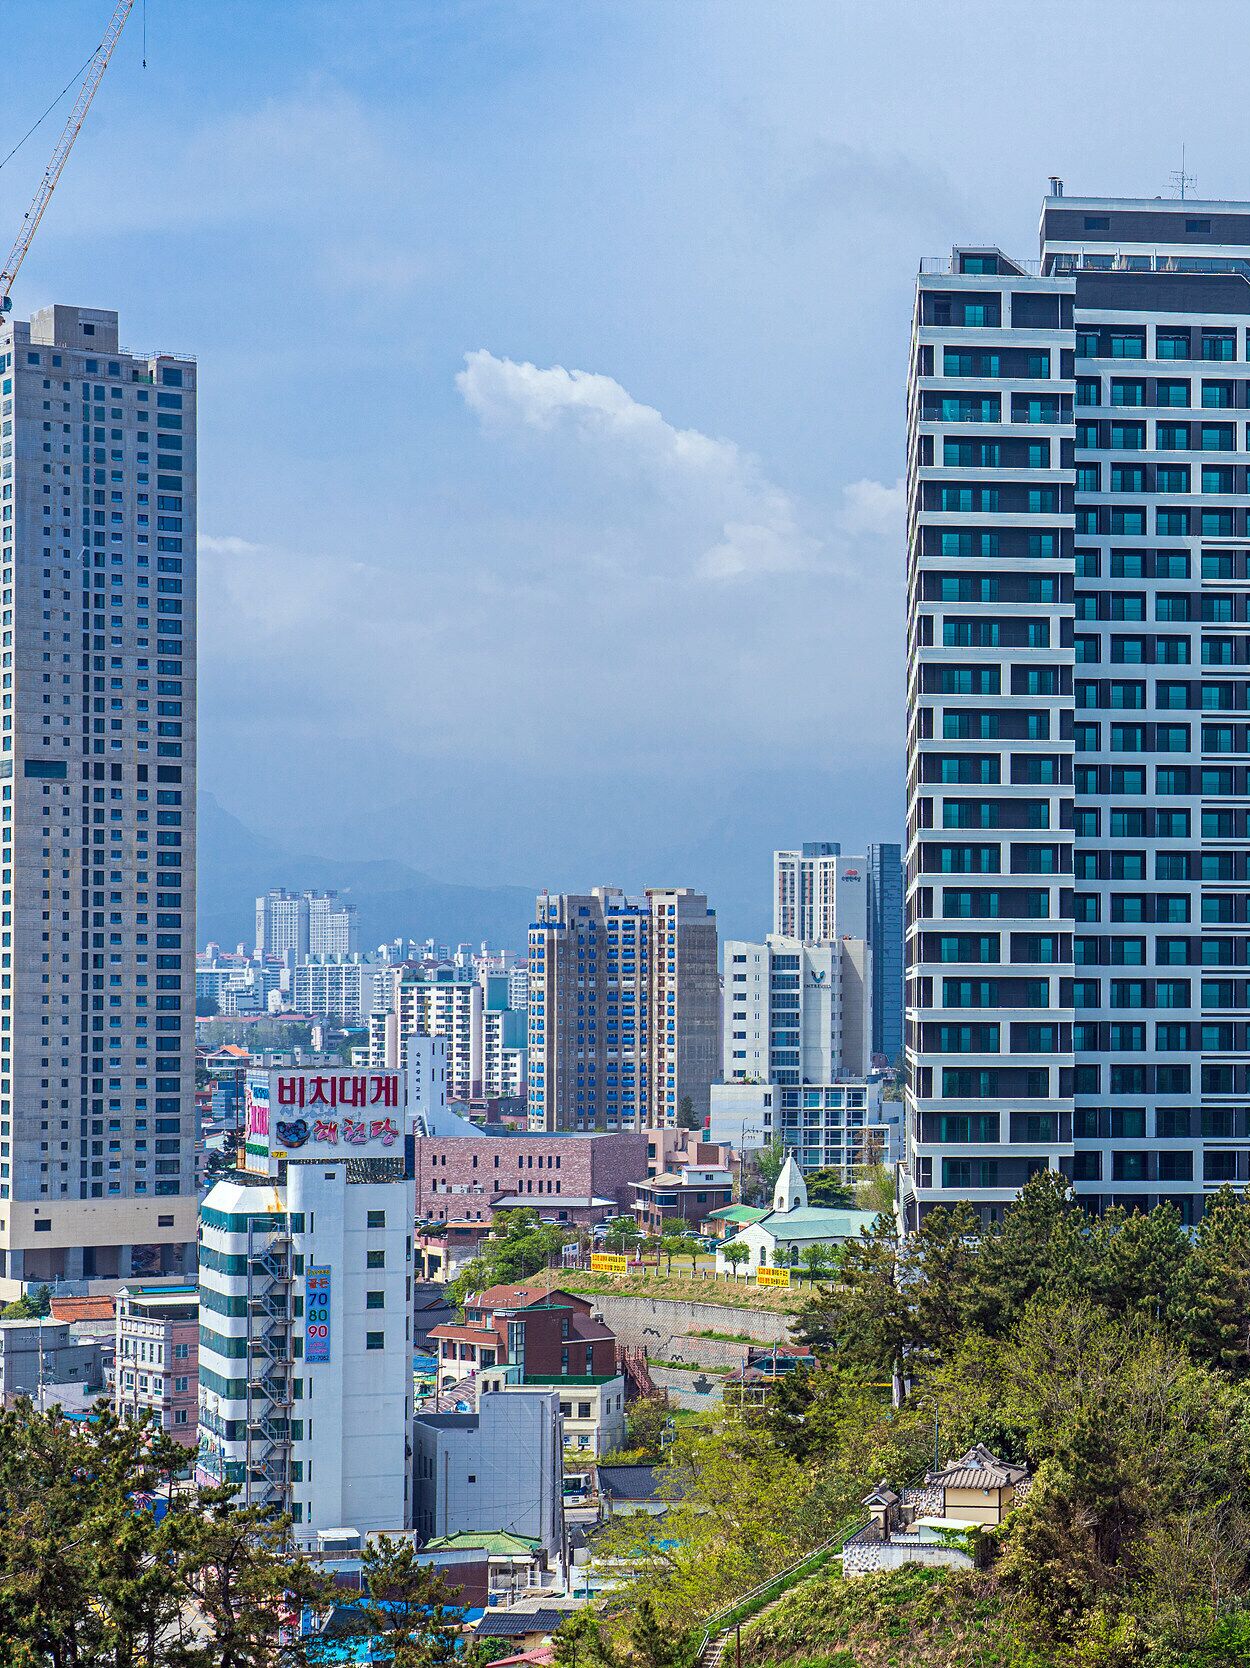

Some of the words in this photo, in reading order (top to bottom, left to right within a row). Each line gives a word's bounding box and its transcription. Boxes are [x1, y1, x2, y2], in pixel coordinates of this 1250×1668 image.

[277, 1075, 398, 1108] 비치대게
[309, 1293, 328, 1306] 70
[308, 1309, 328, 1322] 80
[308, 1325, 328, 1338] 90
